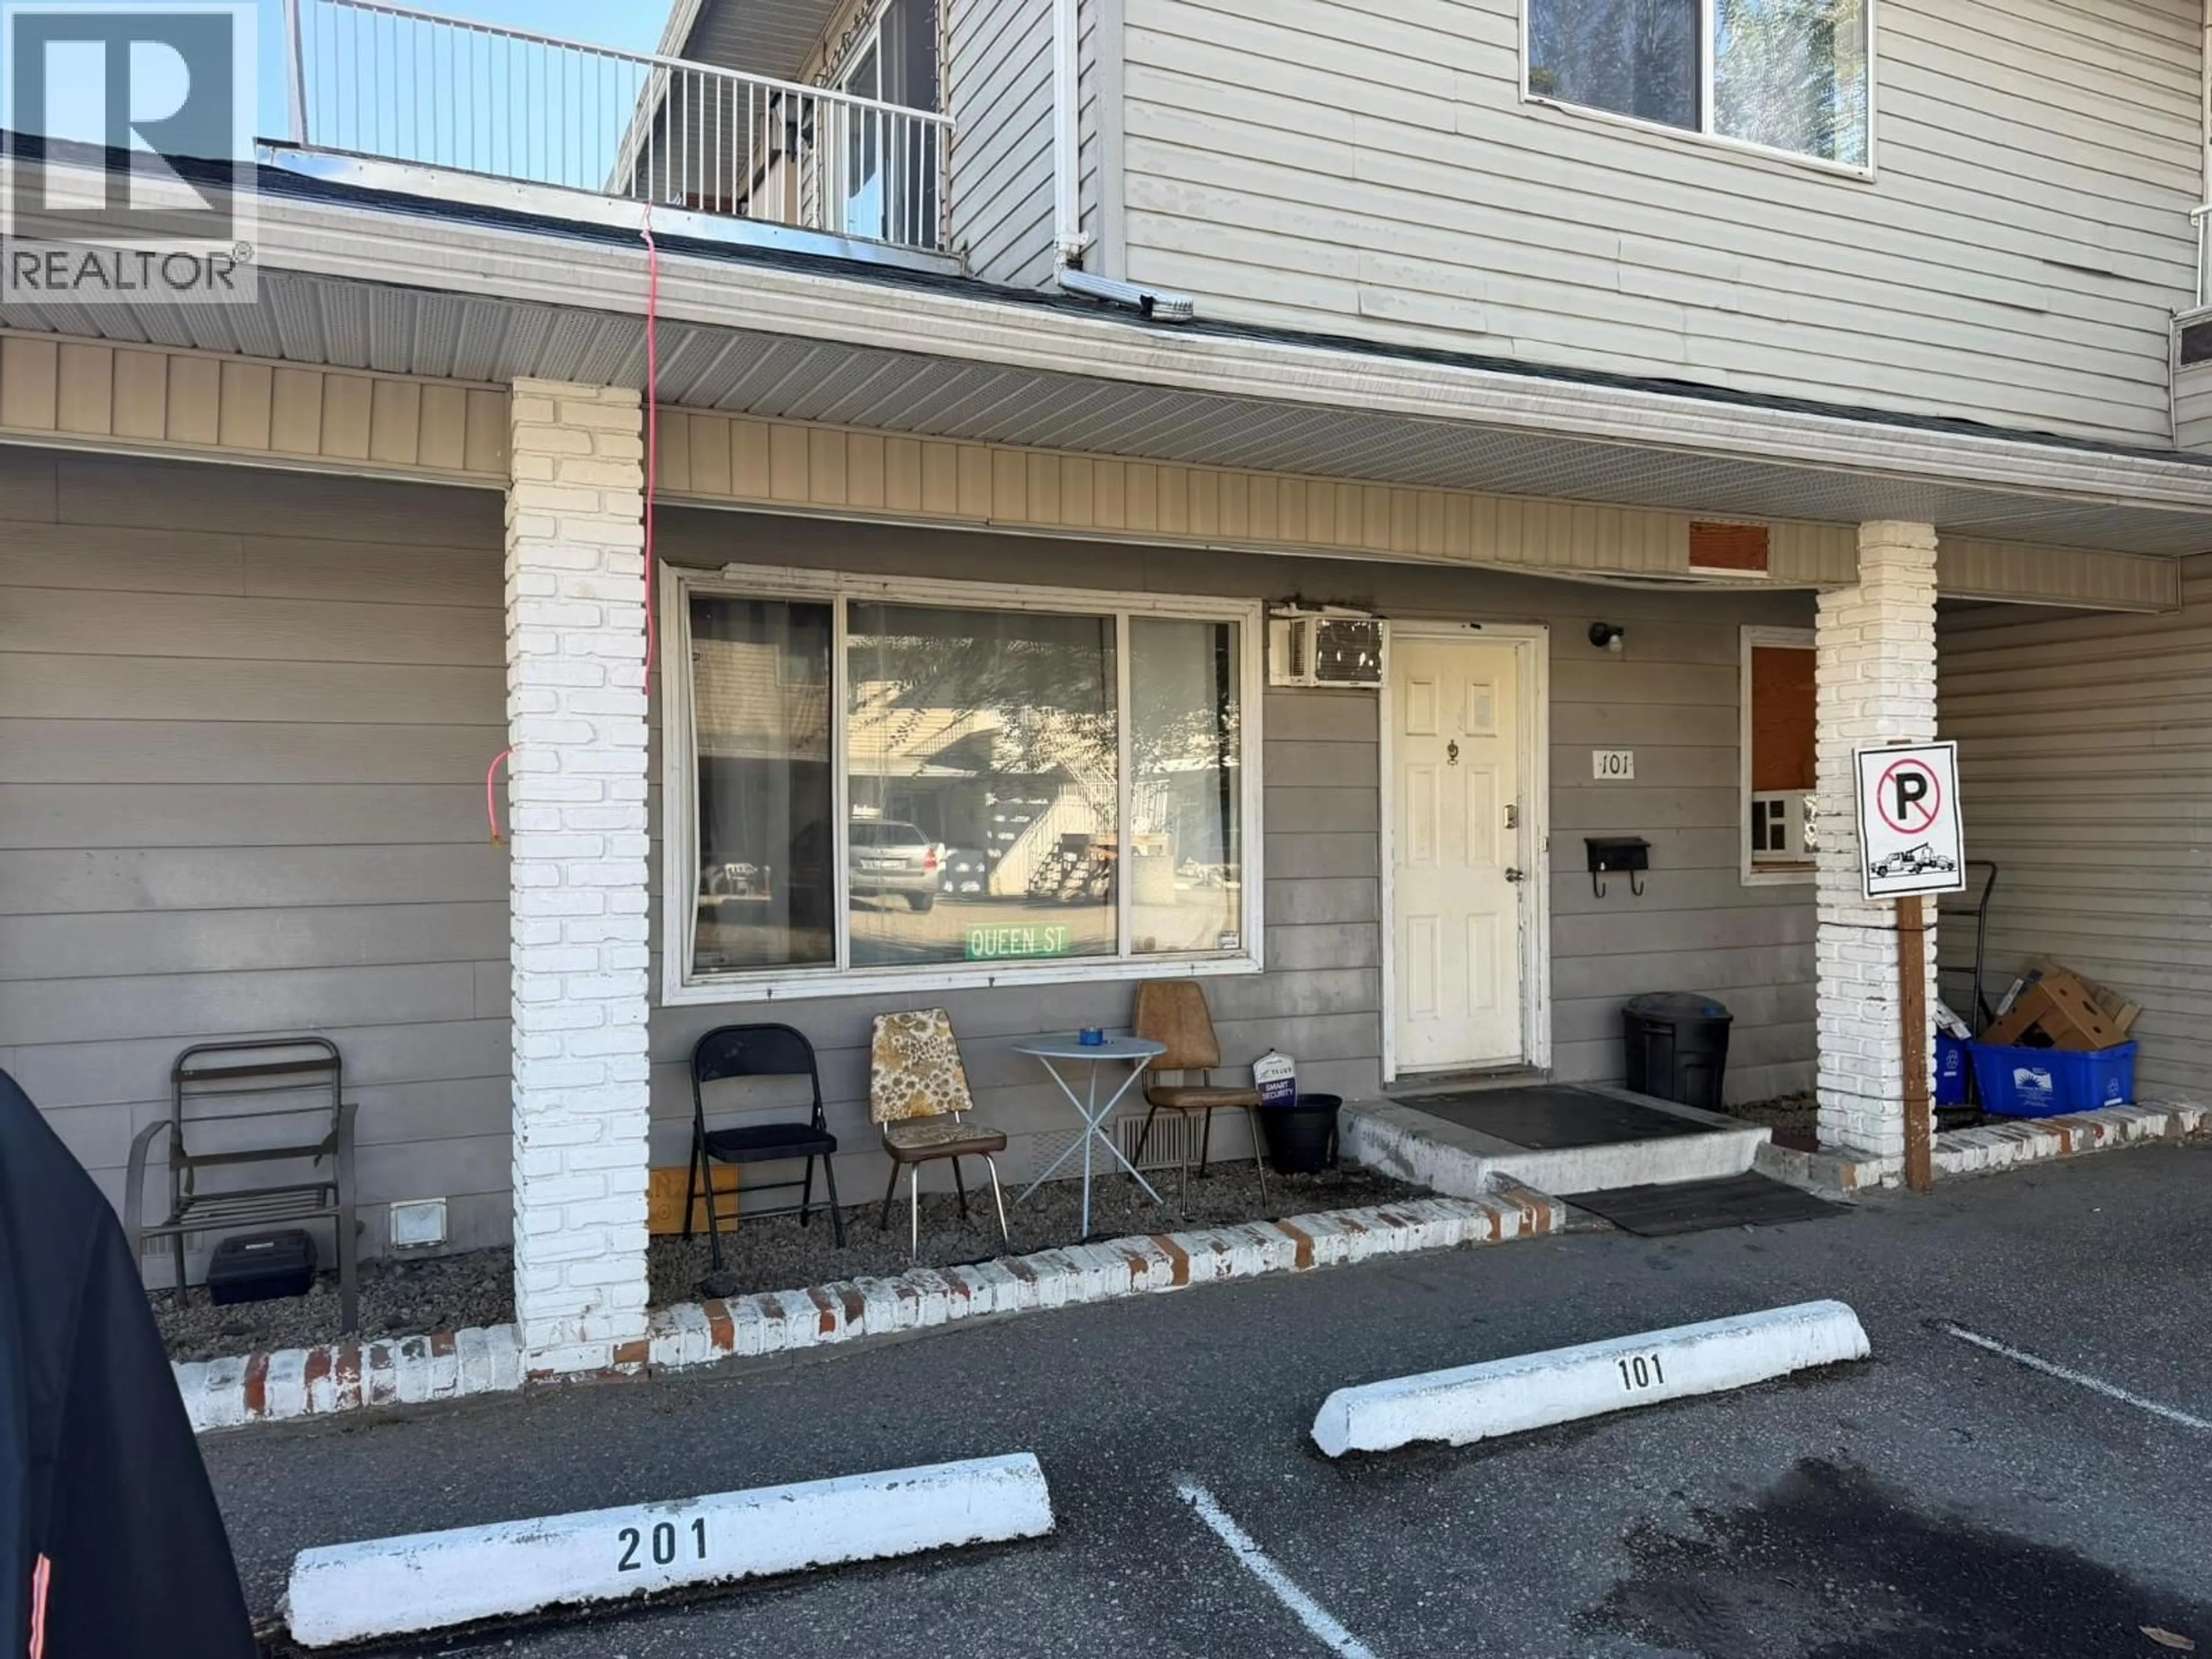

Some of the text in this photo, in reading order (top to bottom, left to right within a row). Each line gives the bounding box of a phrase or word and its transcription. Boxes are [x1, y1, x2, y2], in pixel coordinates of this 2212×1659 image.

[1603, 754, 1628, 775] 101
[1896, 772, 1927, 820] P
[972, 926, 1066, 956] QUEEN ST
[1262, 1088, 1293, 1101] SECURITY
[1265, 1081, 1289, 1092] SMART
[1619, 1353, 1664, 1390] 101
[618, 1517, 706, 1572] 201
